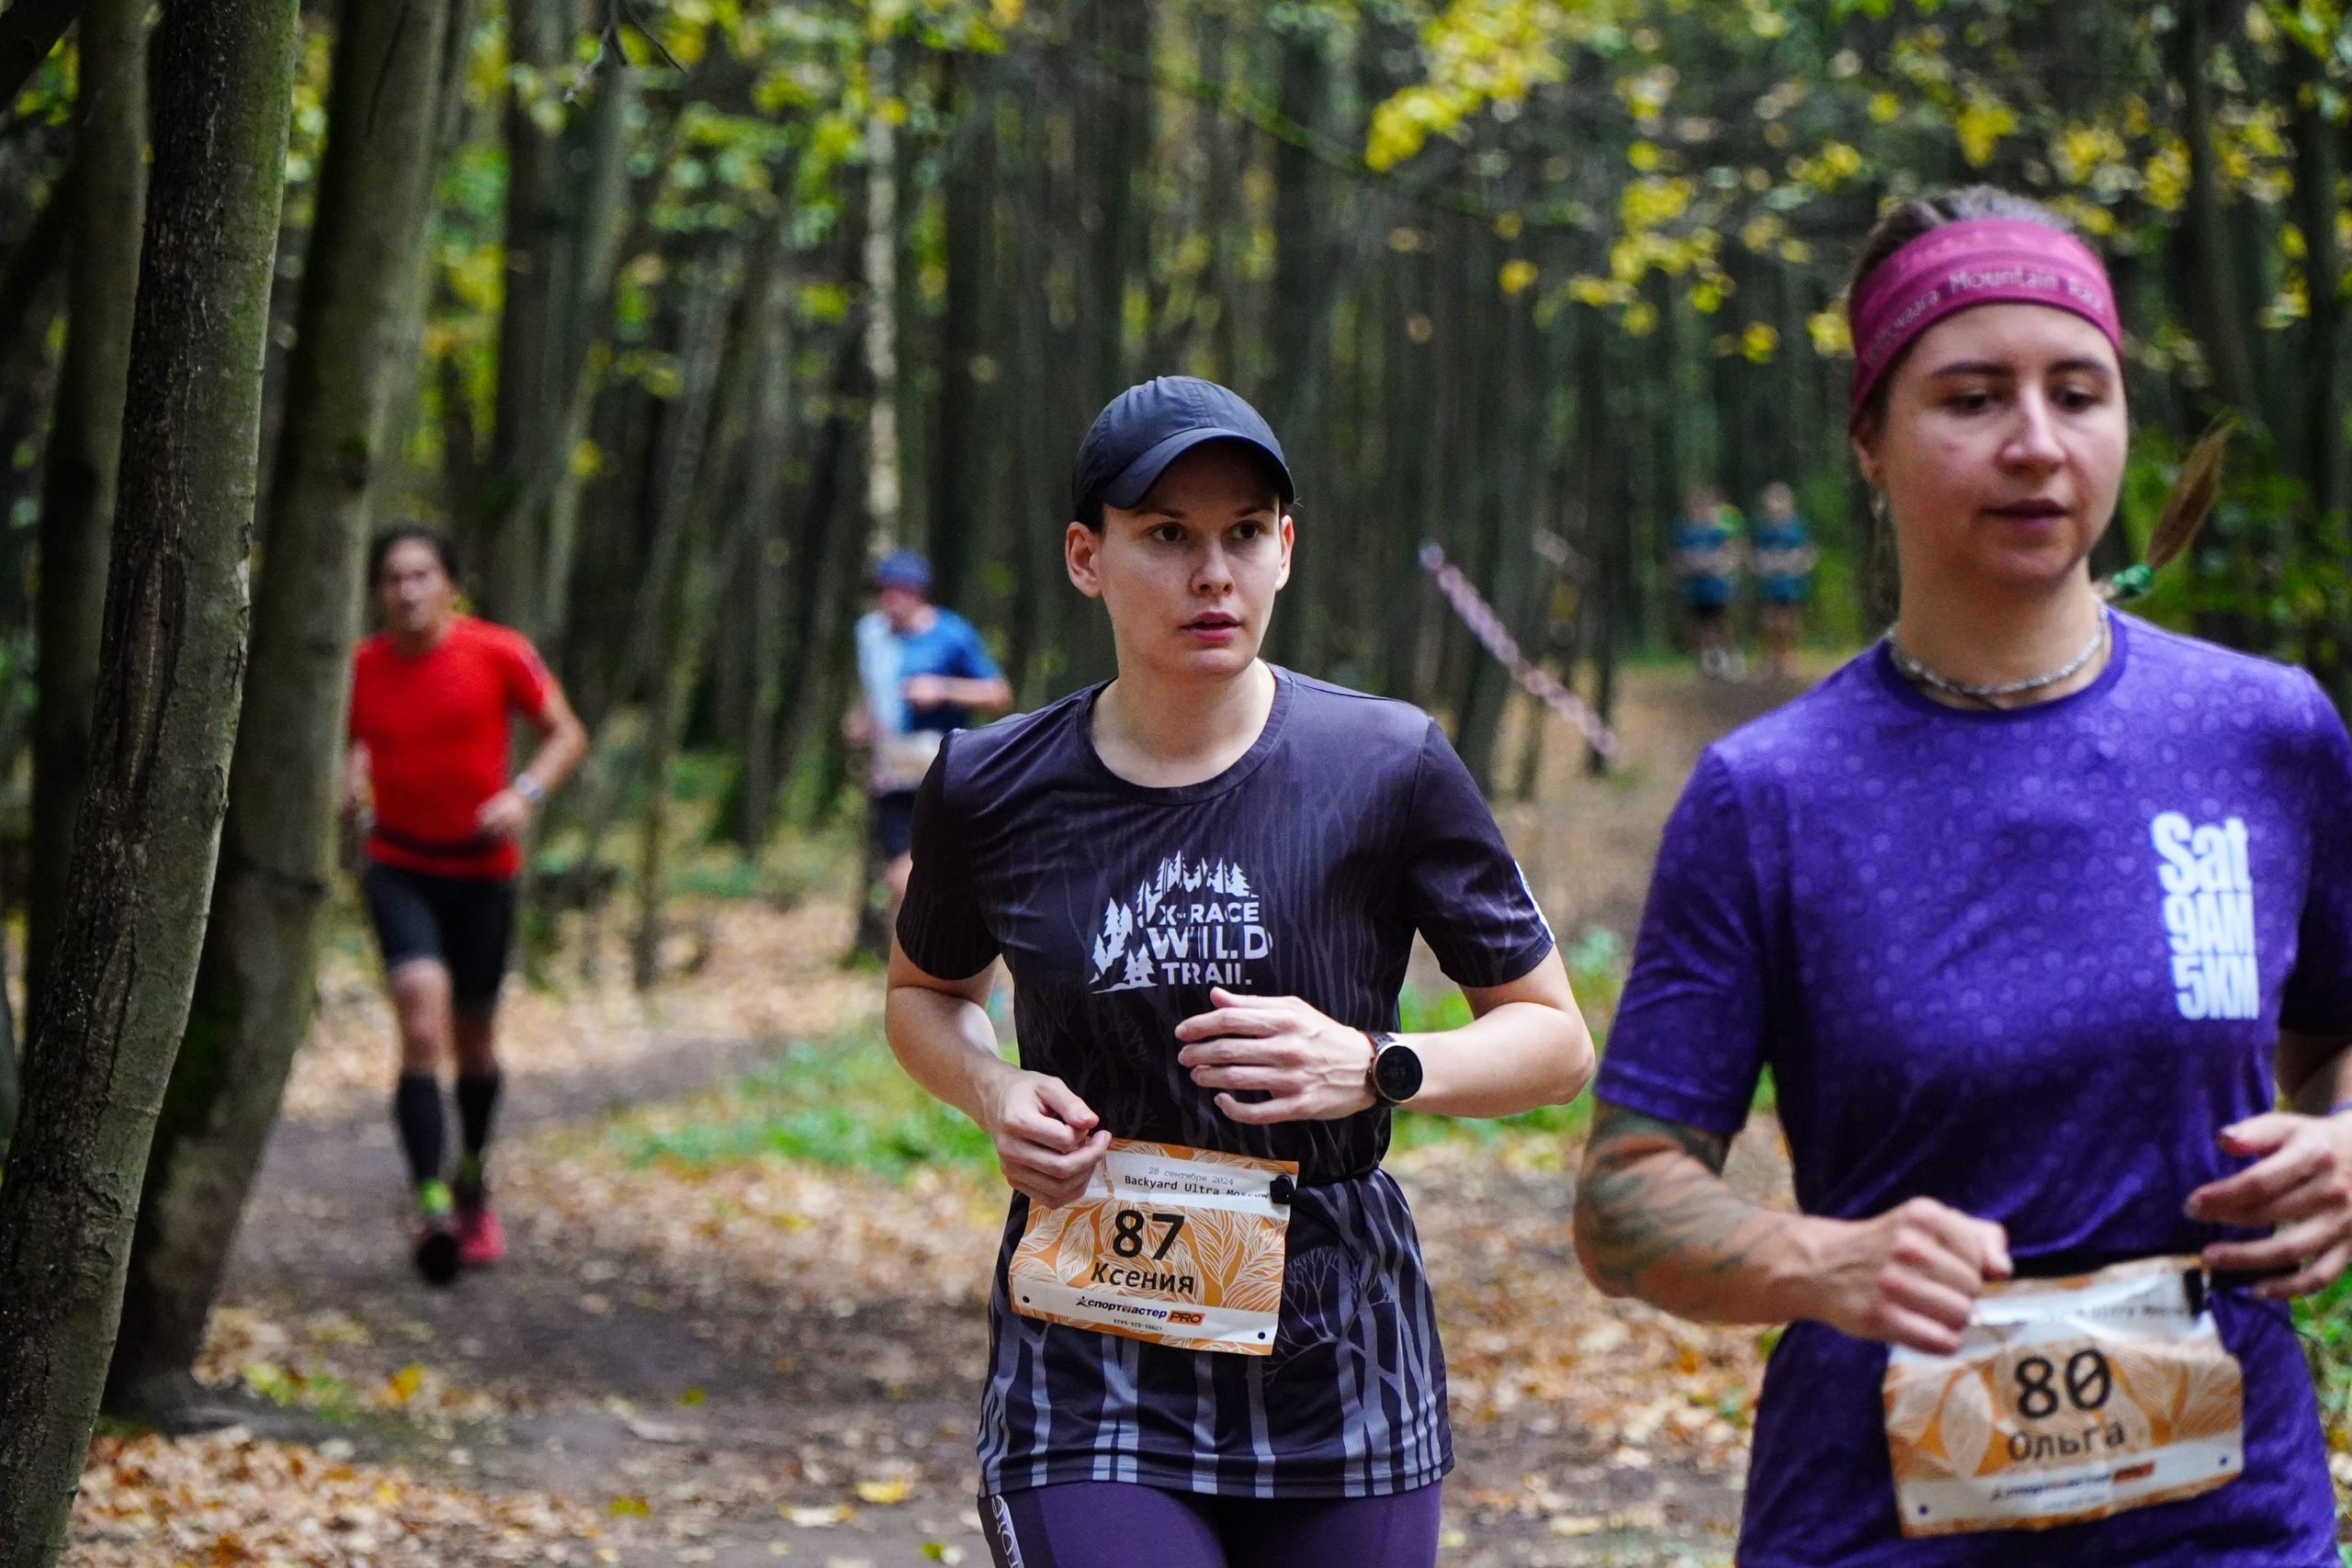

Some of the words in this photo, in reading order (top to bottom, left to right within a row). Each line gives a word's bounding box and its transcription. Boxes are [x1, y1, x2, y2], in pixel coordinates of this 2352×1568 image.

[2152, 810, 2252, 894] Sat
[1147, 924, 1272, 960] WILD
[2164, 892, 2254, 954] 9AM
[1160, 962, 1252, 986] TRAIL
[2172, 953, 2258, 1021] 5KM
[1125, 1175, 1179, 1191] Backyard
[1184, 1181, 1220, 1197] Ultra
[1148, 1167, 1160, 1177] 28
[1164, 1169, 1207, 1183] сентября
[1212, 1175, 1234, 1186] 2024
[1112, 1209, 1185, 1261] 87
[1091, 1262, 1194, 1295] Ксения
[1170, 1311, 1203, 1325] PRO
[2014, 1348, 2112, 1419] 80
[2008, 1420, 2126, 1462] Ольга
